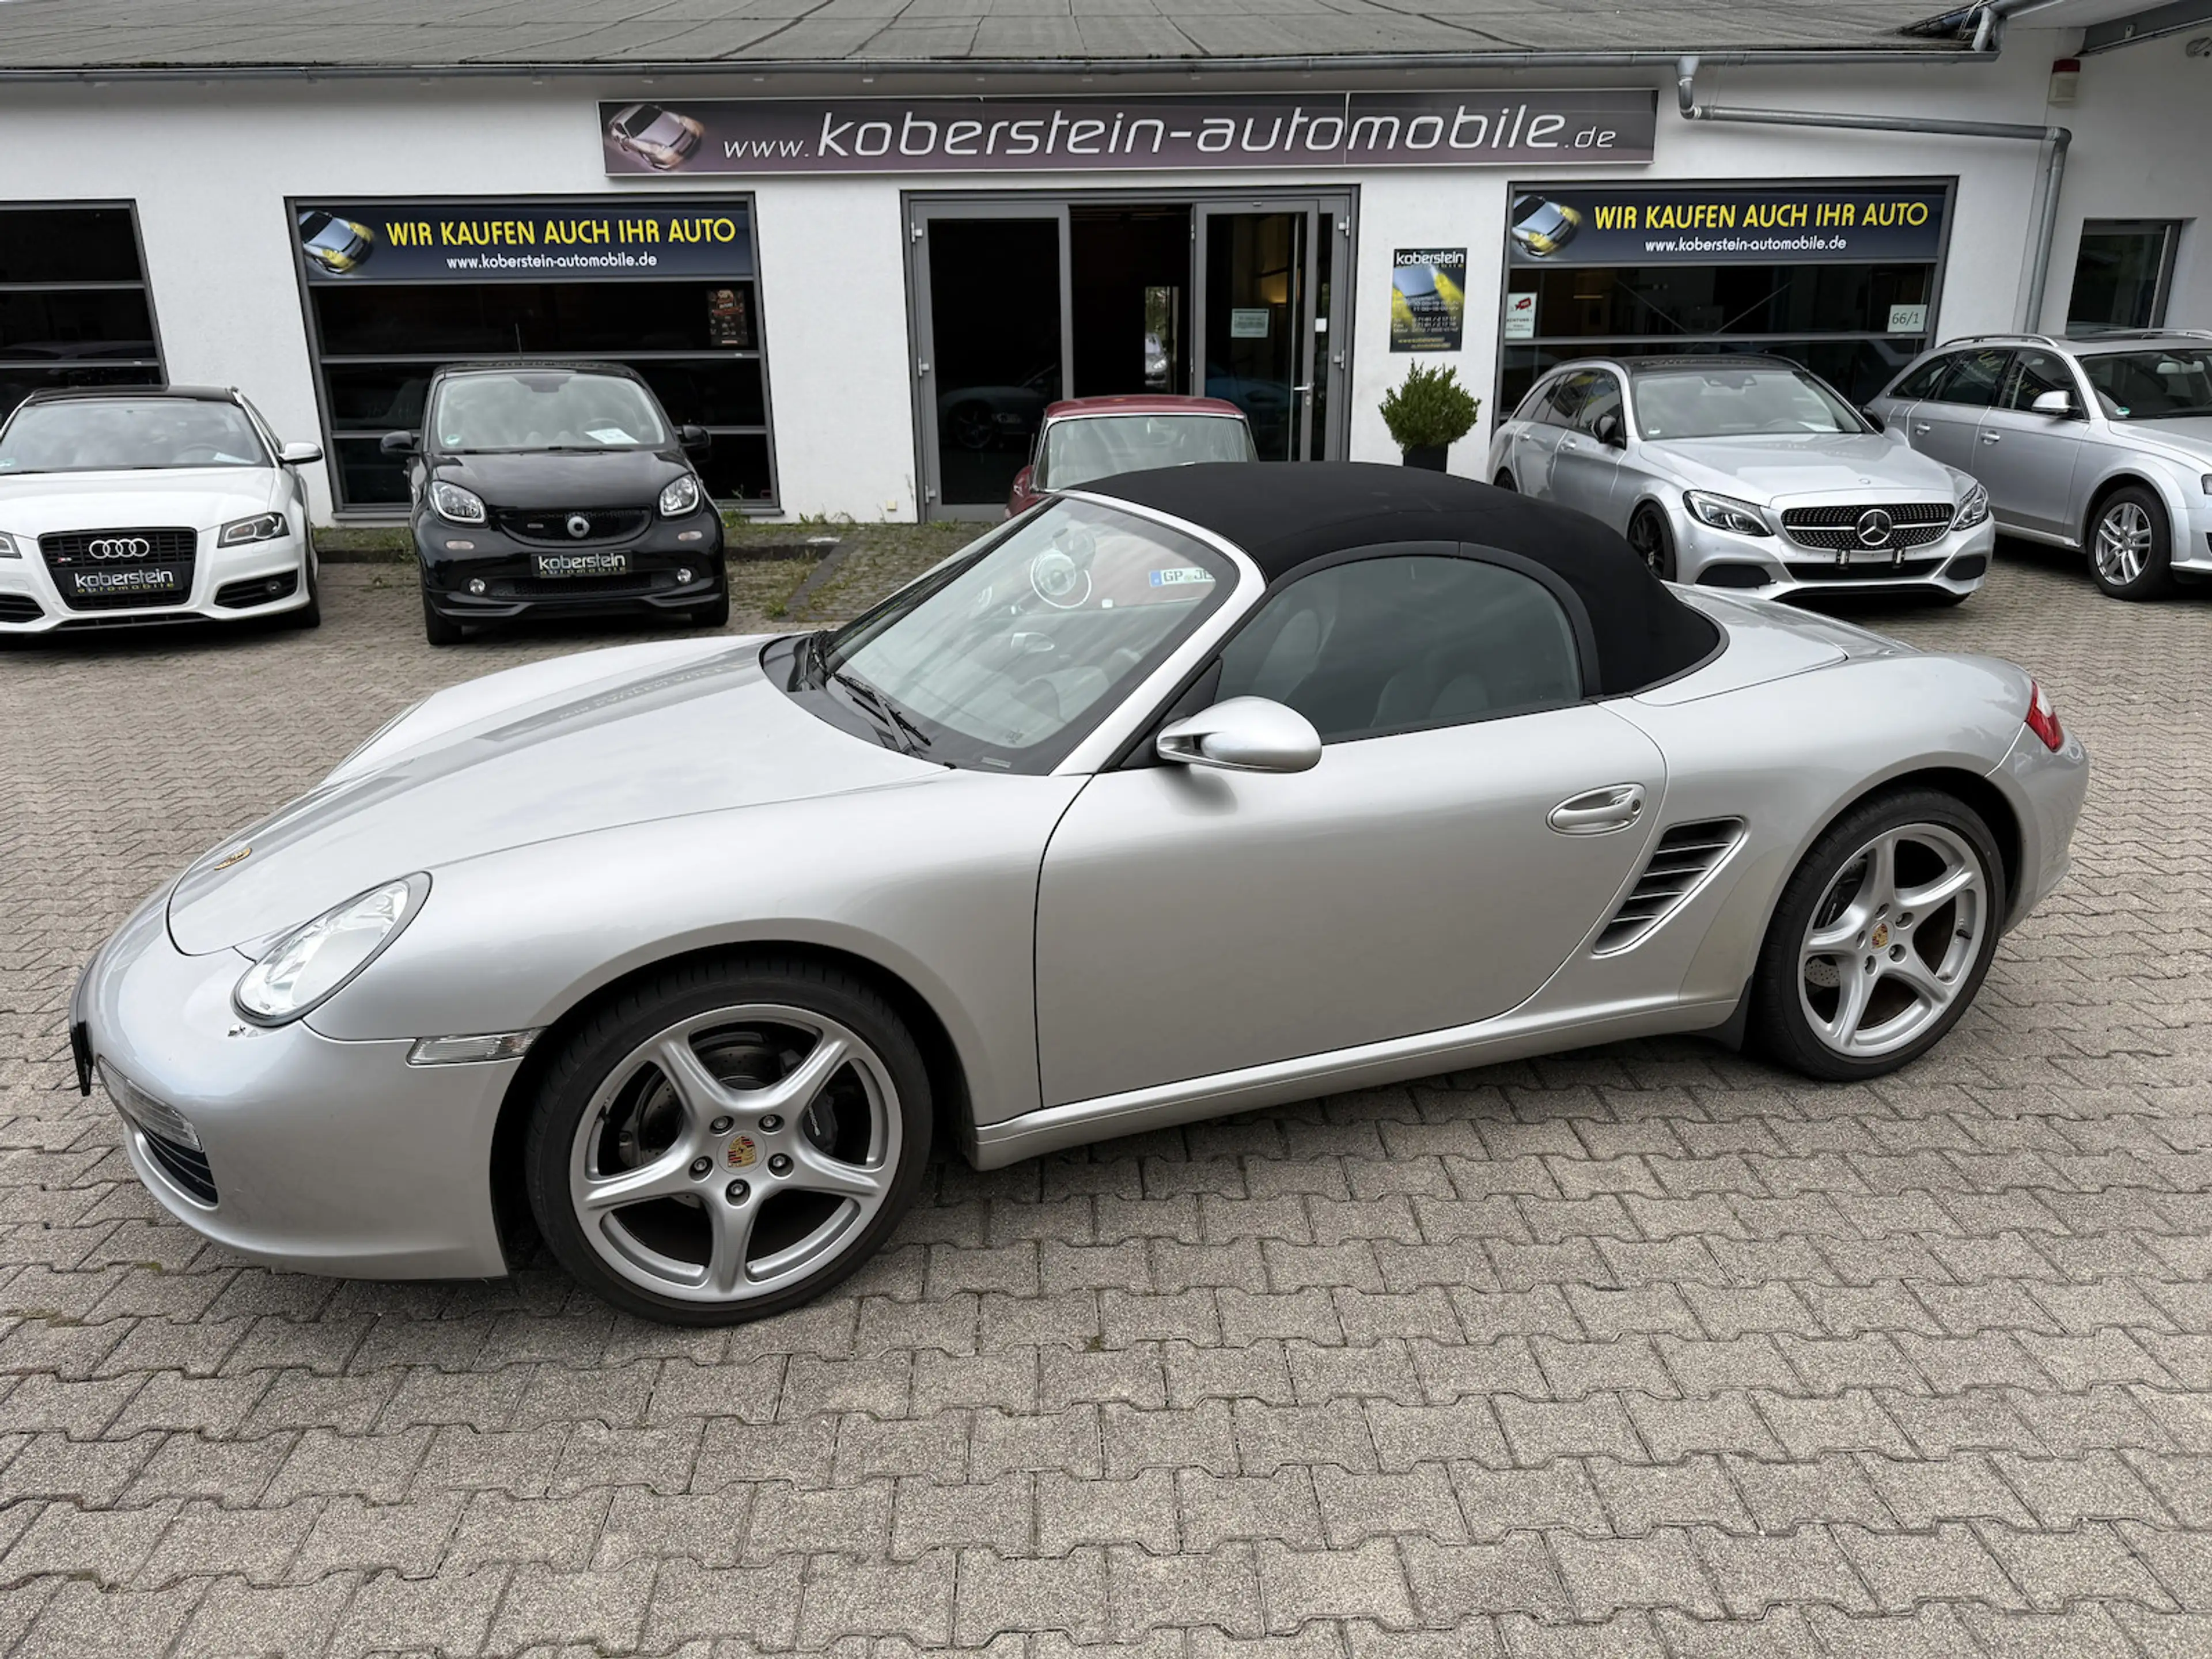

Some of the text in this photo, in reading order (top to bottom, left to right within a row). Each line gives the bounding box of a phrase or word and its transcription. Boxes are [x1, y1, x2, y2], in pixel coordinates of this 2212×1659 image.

[724, 104, 1616, 158] www.koberstein-automobile.de
[1594, 202, 1929, 230] WIR KAUFEN AUCH IHR AUTO
[385, 217, 736, 246] WIR KAUFEN AUCH IHR AUTO
[1645, 234, 1847, 252] www.koberstein-automobile.de
[446, 251, 658, 269] www.koberstein-automobile.de
[1396, 251, 1464, 265] koberstein
[1892, 311, 1919, 327] 66/1
[539, 552, 626, 570] koberstein
[74, 568, 174, 588] koberstein
[1164, 570, 1183, 582] GP
[77, 582, 175, 594] automobile
